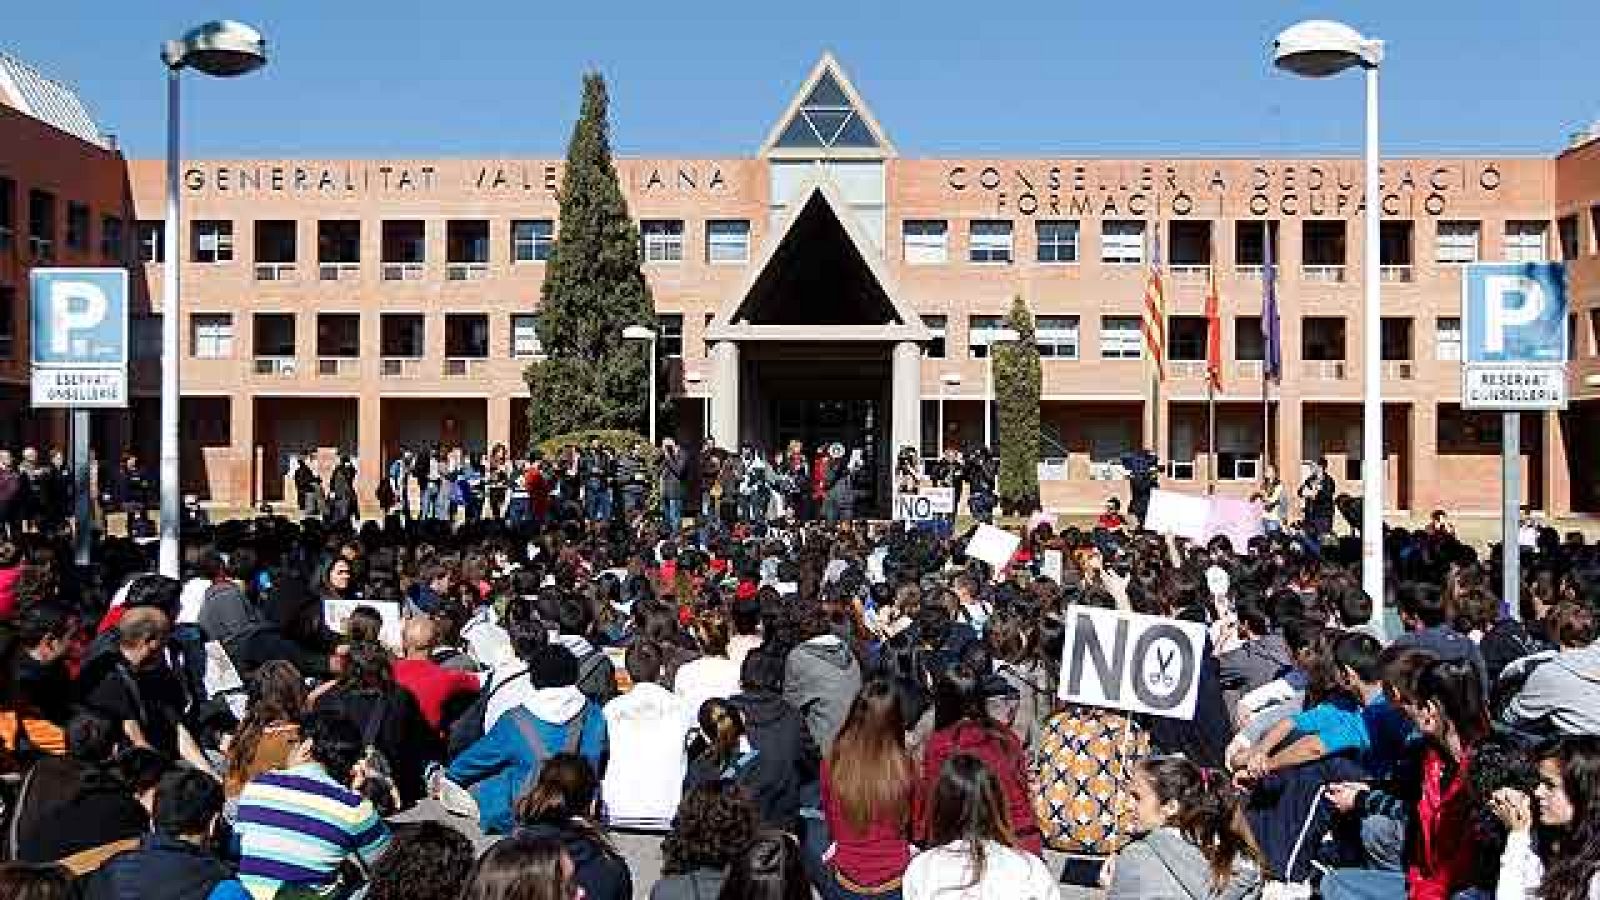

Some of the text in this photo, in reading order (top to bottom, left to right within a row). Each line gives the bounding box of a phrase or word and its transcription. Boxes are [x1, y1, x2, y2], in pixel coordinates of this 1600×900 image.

[184, 166, 728, 191] GENERALITAT VALEIANA
[948, 166, 1226, 191] CONSELLERIA
[998, 189, 1193, 216] FORMACIÓ
[51, 280, 107, 354] P
[1484, 276, 1545, 352] P
[899, 497, 931, 518] NO
[1067, 612, 1195, 710] NO
